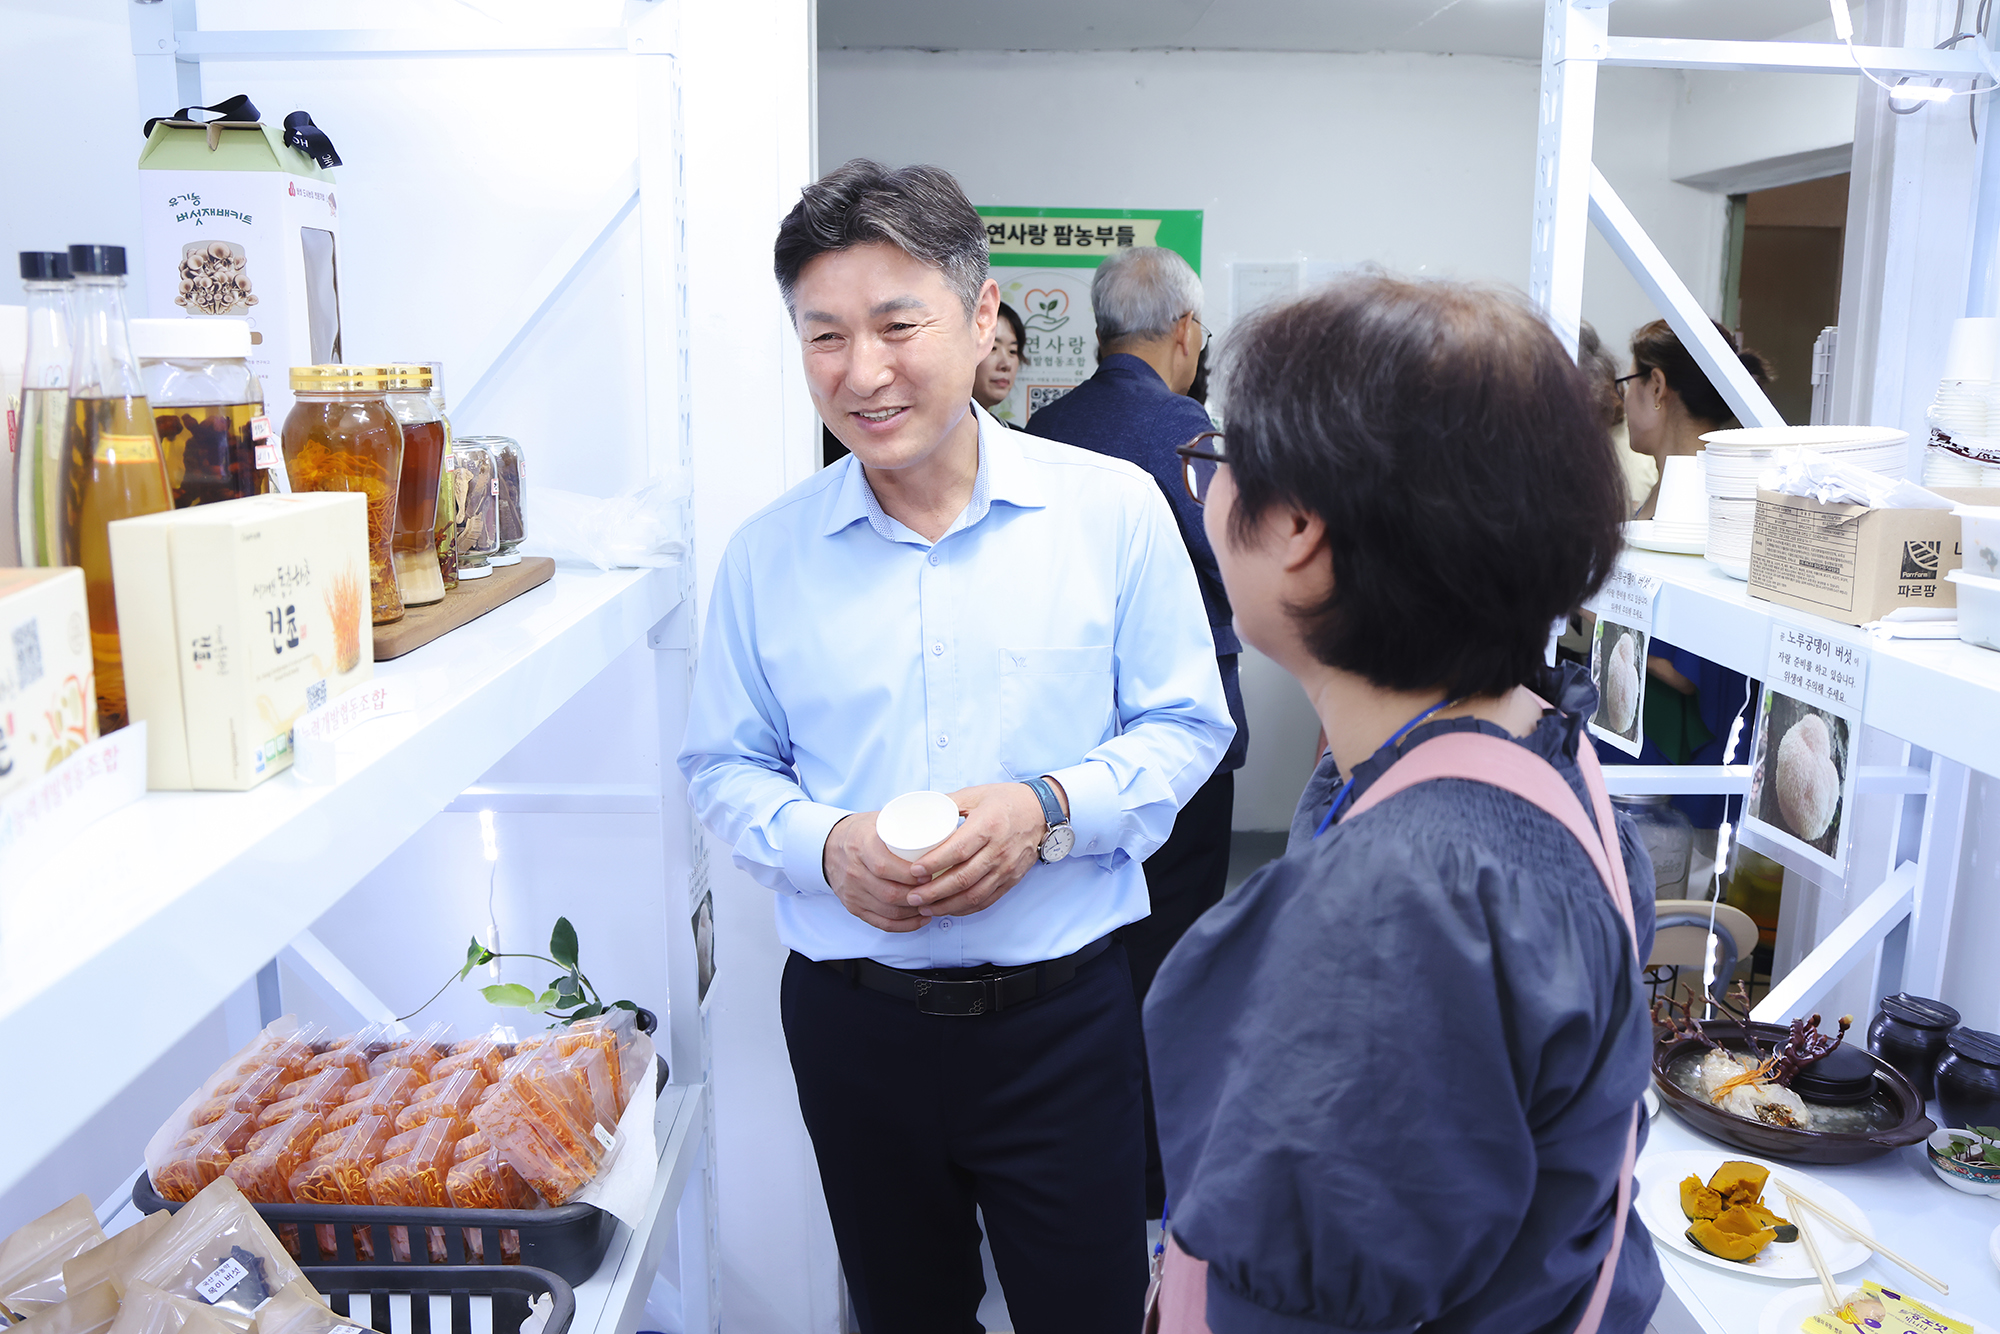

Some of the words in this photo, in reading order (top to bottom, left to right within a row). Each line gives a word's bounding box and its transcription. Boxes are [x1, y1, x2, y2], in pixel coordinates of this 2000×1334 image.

[168, 192, 201, 207] 유기농
[176, 208, 252, 226] 버섯재배키트
[987, 223, 1048, 245] 연사랑
[1053, 223, 1135, 247] 팜농부들
[1027, 356, 1086, 367] 발협동조합
[1897, 584, 1938, 598] 파르팜
[266, 604, 299, 654] 건초
[1787, 630, 1831, 658] 노루궁뎅이
[1777, 651, 1791, 665] 자랄
[1793, 656, 1812, 672] 준비를
[1815, 664, 1828, 677] 하고
[1784, 670, 1803, 687] 위생에
[1805, 678, 1824, 695] 주의해
[202, 1276, 214, 1287] 국산
[207, 1280, 225, 1294] 목이
[223, 1267, 241, 1281] 버섯
